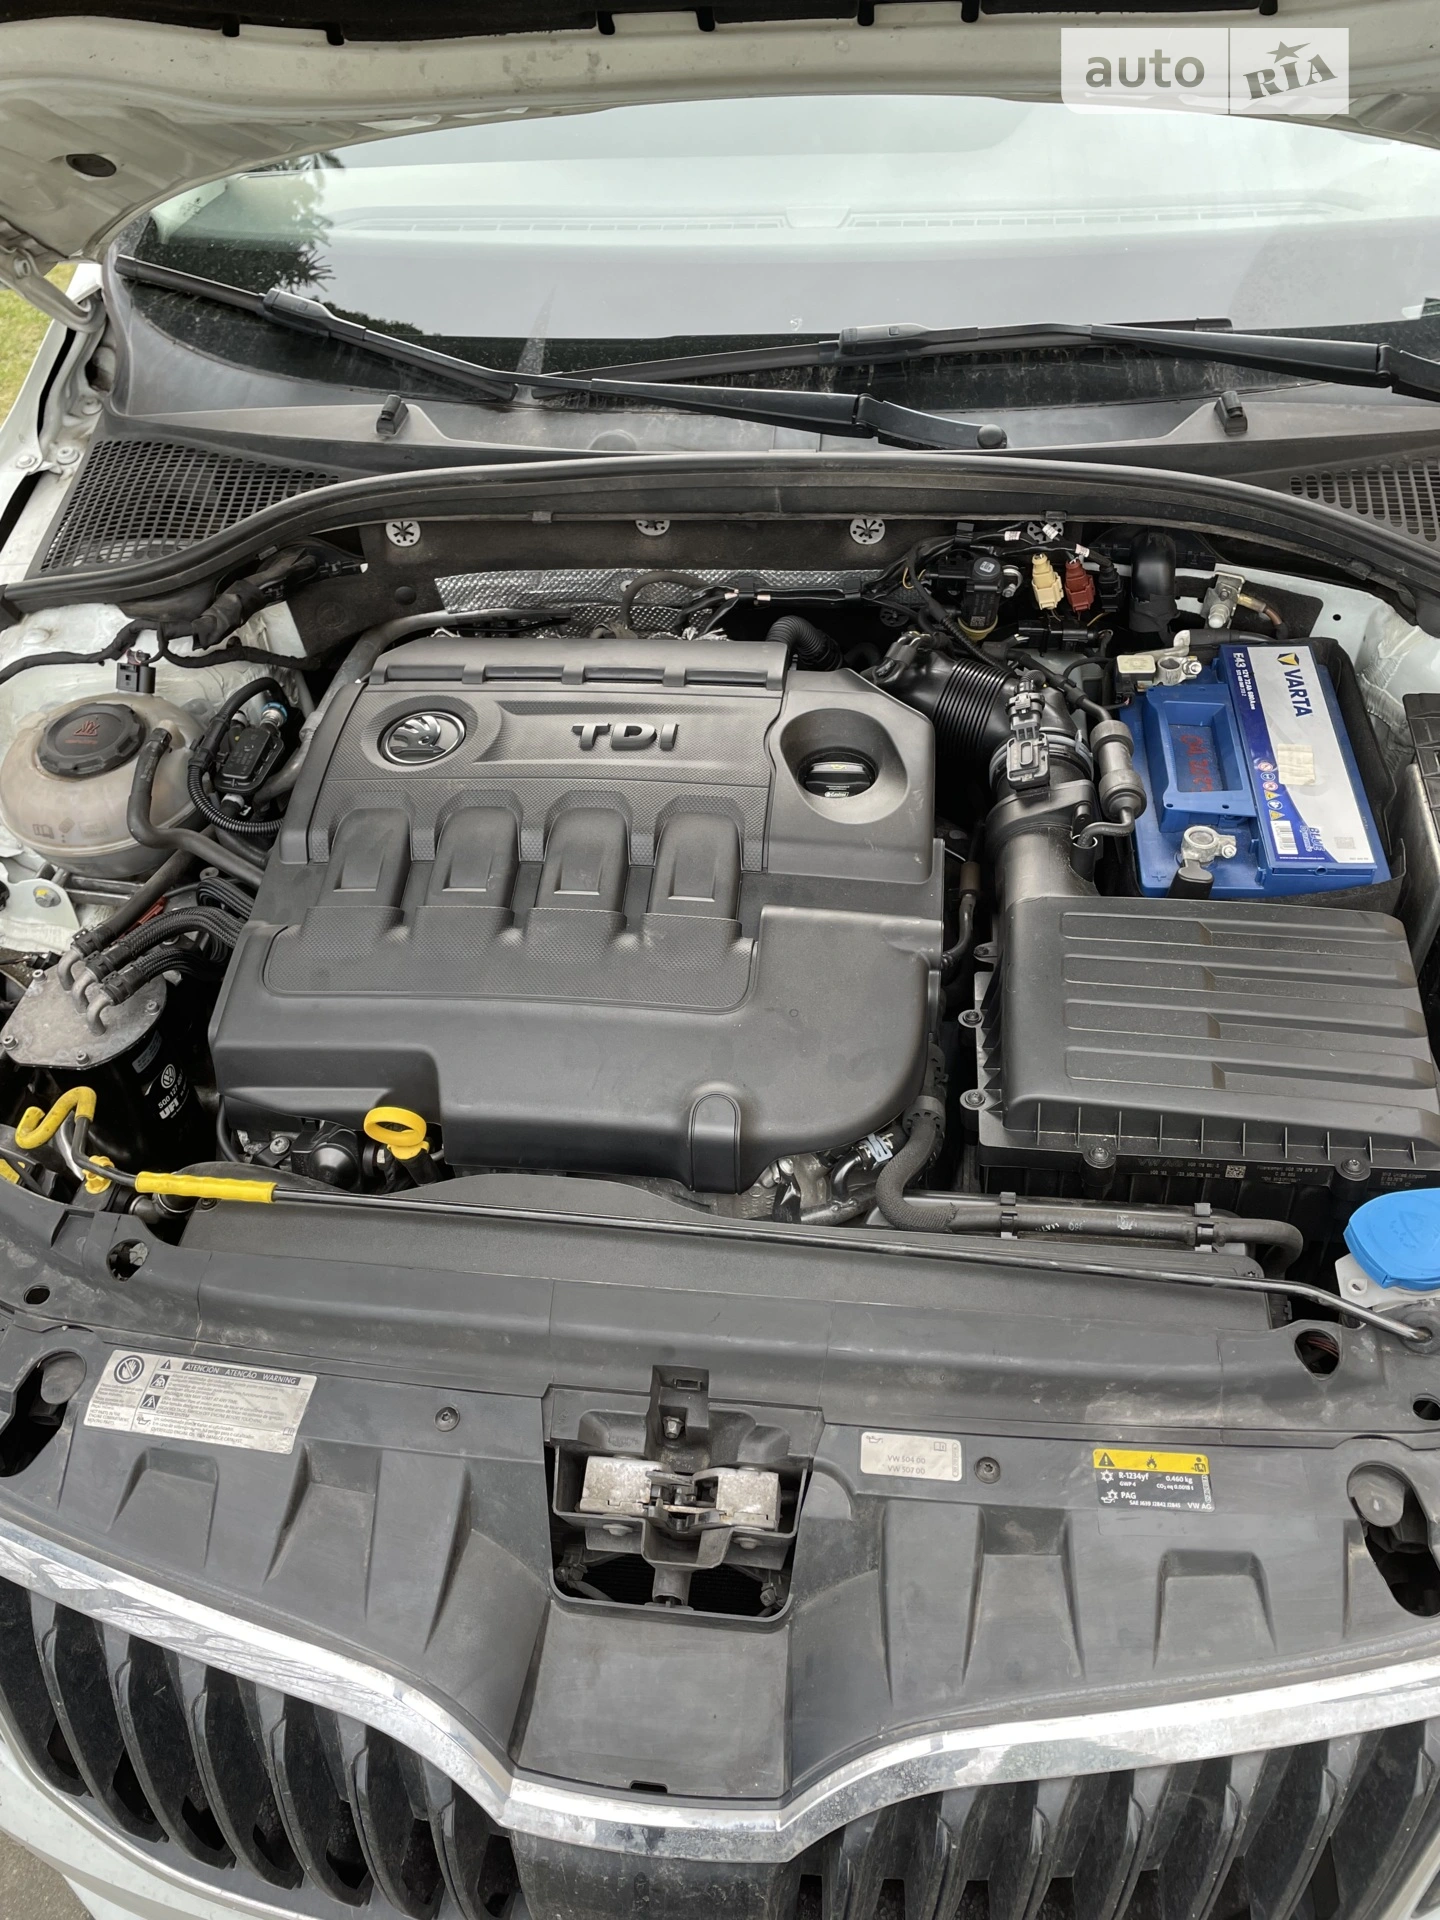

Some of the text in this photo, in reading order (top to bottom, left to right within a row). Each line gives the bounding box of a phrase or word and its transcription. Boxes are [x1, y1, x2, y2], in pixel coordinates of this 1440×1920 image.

[1233, 653, 1247, 668] E43
[1284, 668, 1313, 717] VARTA
[571, 722, 680, 751] TDI
[185, 1363, 296, 1384] ATENCIÓN ATENÇÃO WARNING
[1119, 1472, 1149, 1482] R-1234yf
[1121, 1491, 1136, 1500] PAG
